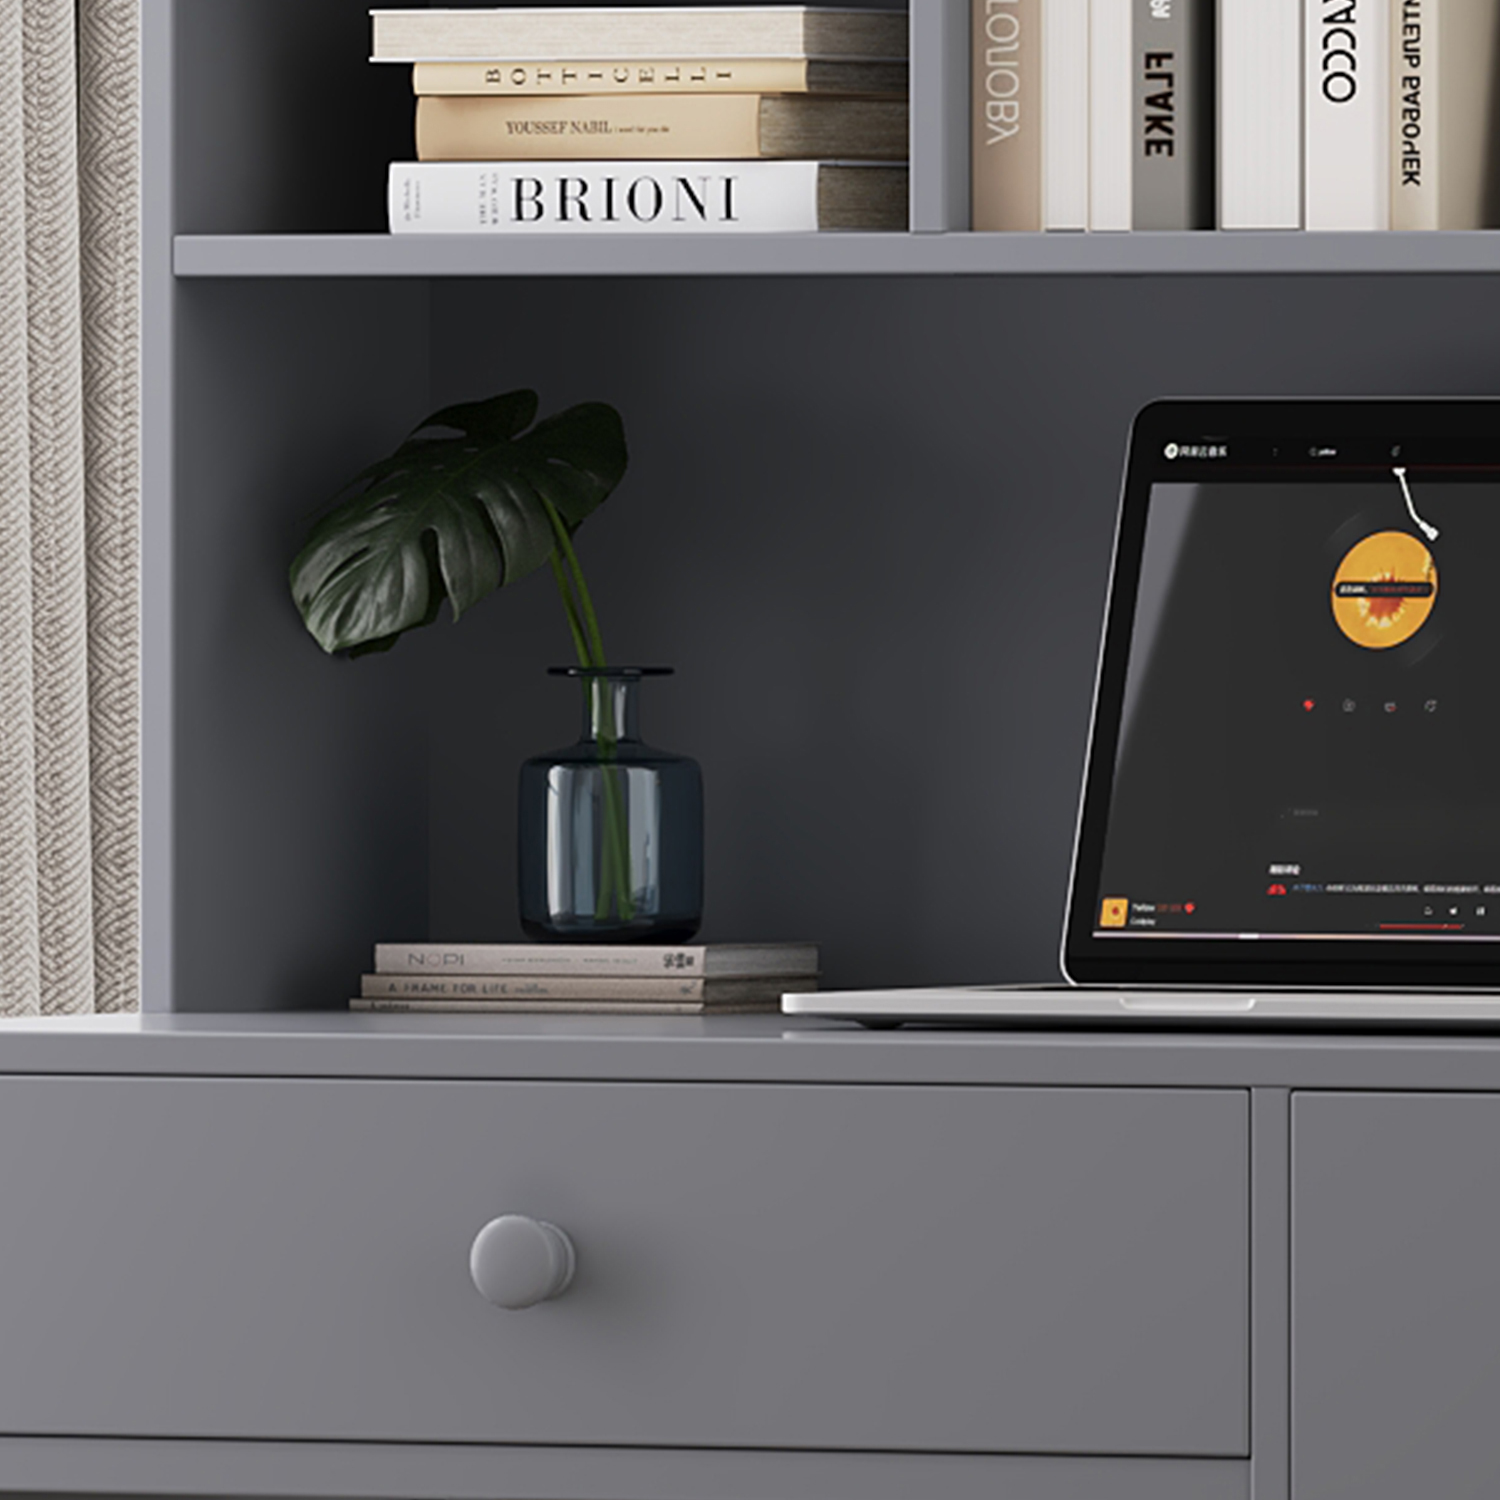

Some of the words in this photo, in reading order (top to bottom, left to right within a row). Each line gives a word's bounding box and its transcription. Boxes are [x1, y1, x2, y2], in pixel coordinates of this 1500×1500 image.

[485, 67, 732, 86] BOTTICELLI
[504, 120, 569, 135] YOUSSEF
[512, 176, 739, 223] BRIONI
[452, 982, 479, 994] FOR
